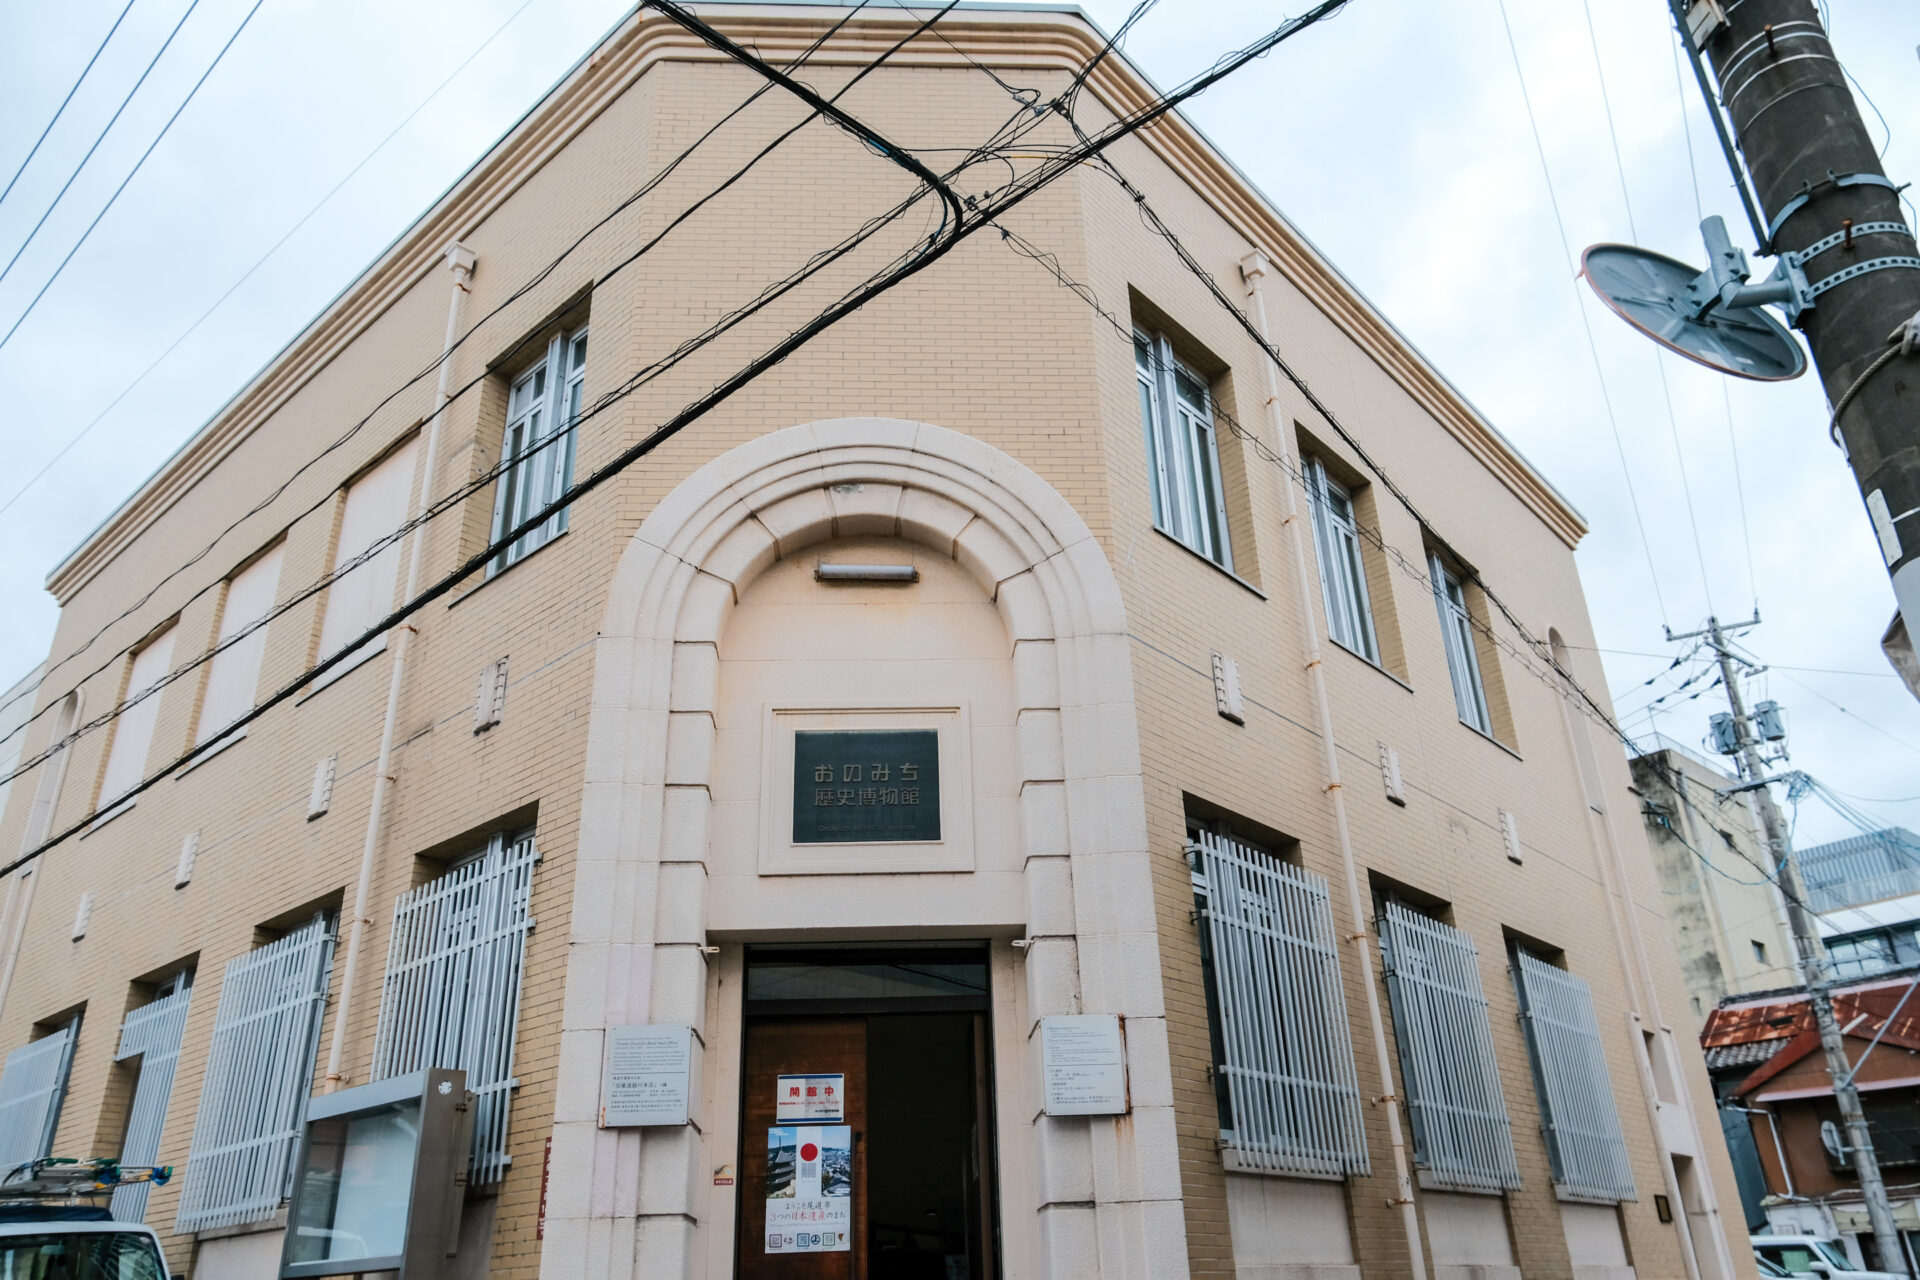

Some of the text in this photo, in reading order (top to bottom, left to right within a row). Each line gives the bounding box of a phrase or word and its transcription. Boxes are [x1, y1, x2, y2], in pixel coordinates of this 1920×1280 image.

[814, 762, 919, 782] おのみち
[814, 786, 920, 806] 歴史博物館
[789, 1086, 835, 1098] 開館中
